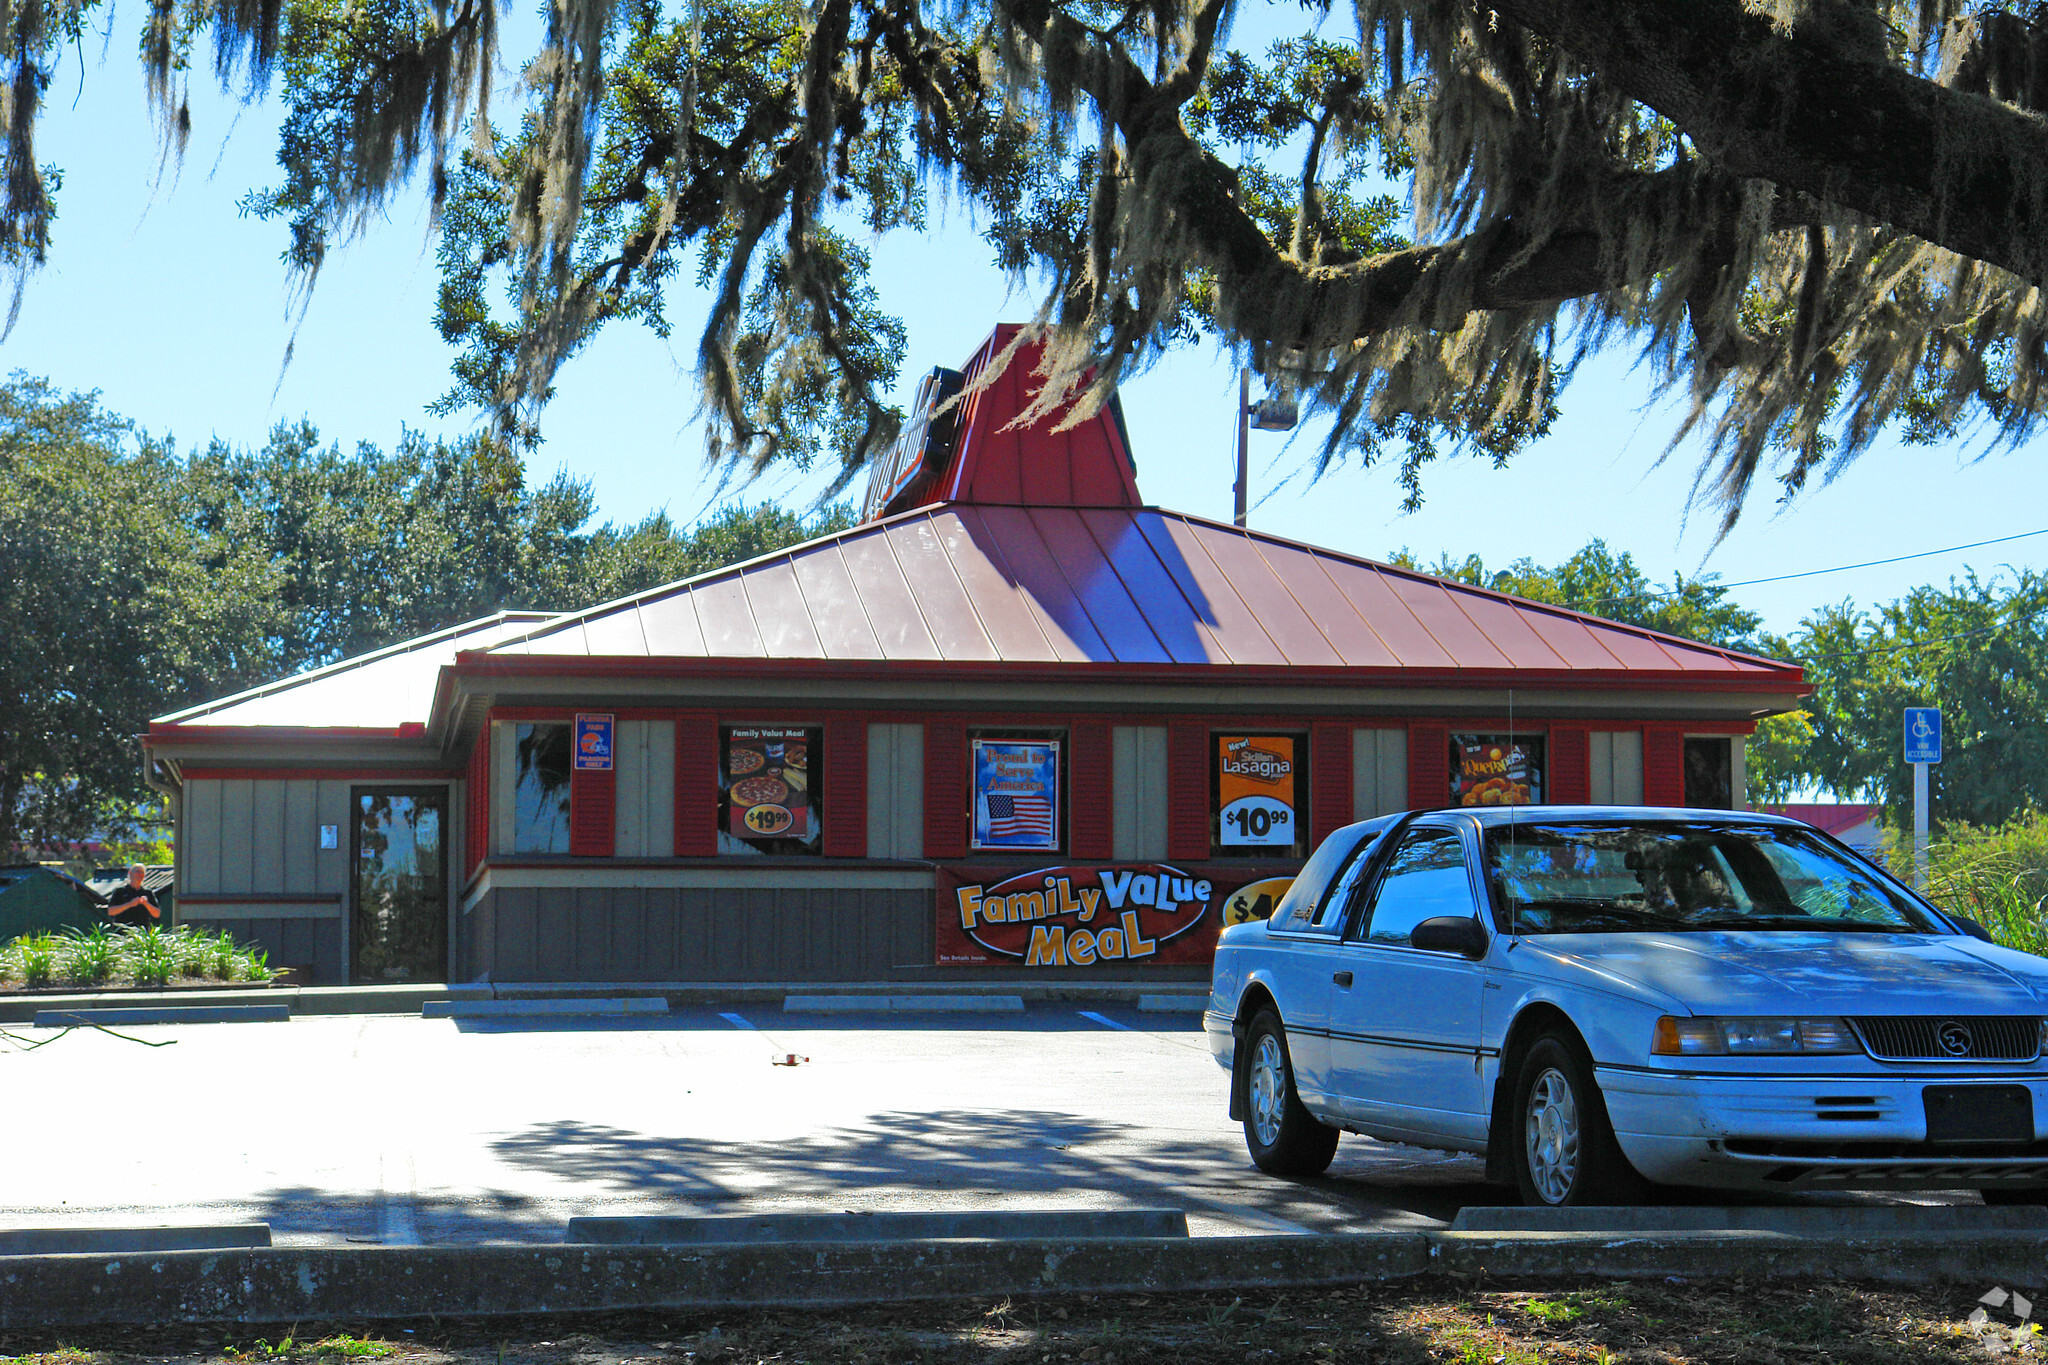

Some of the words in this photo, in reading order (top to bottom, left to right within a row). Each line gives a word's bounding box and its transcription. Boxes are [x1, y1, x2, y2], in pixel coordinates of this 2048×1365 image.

[732, 729, 760, 738] Family
[761, 729, 783, 737] Value
[785, 729, 805, 737] Meal
[1227, 738, 1250, 752] New!
[986, 748, 1028, 763] Proud
[1031, 752, 1046, 764] to
[1907, 750, 1939, 758] ACCESSIBLE
[996, 762, 1036, 778] Serve
[1223, 757, 1291, 777] Lasagna
[987, 776, 1045, 792] America
